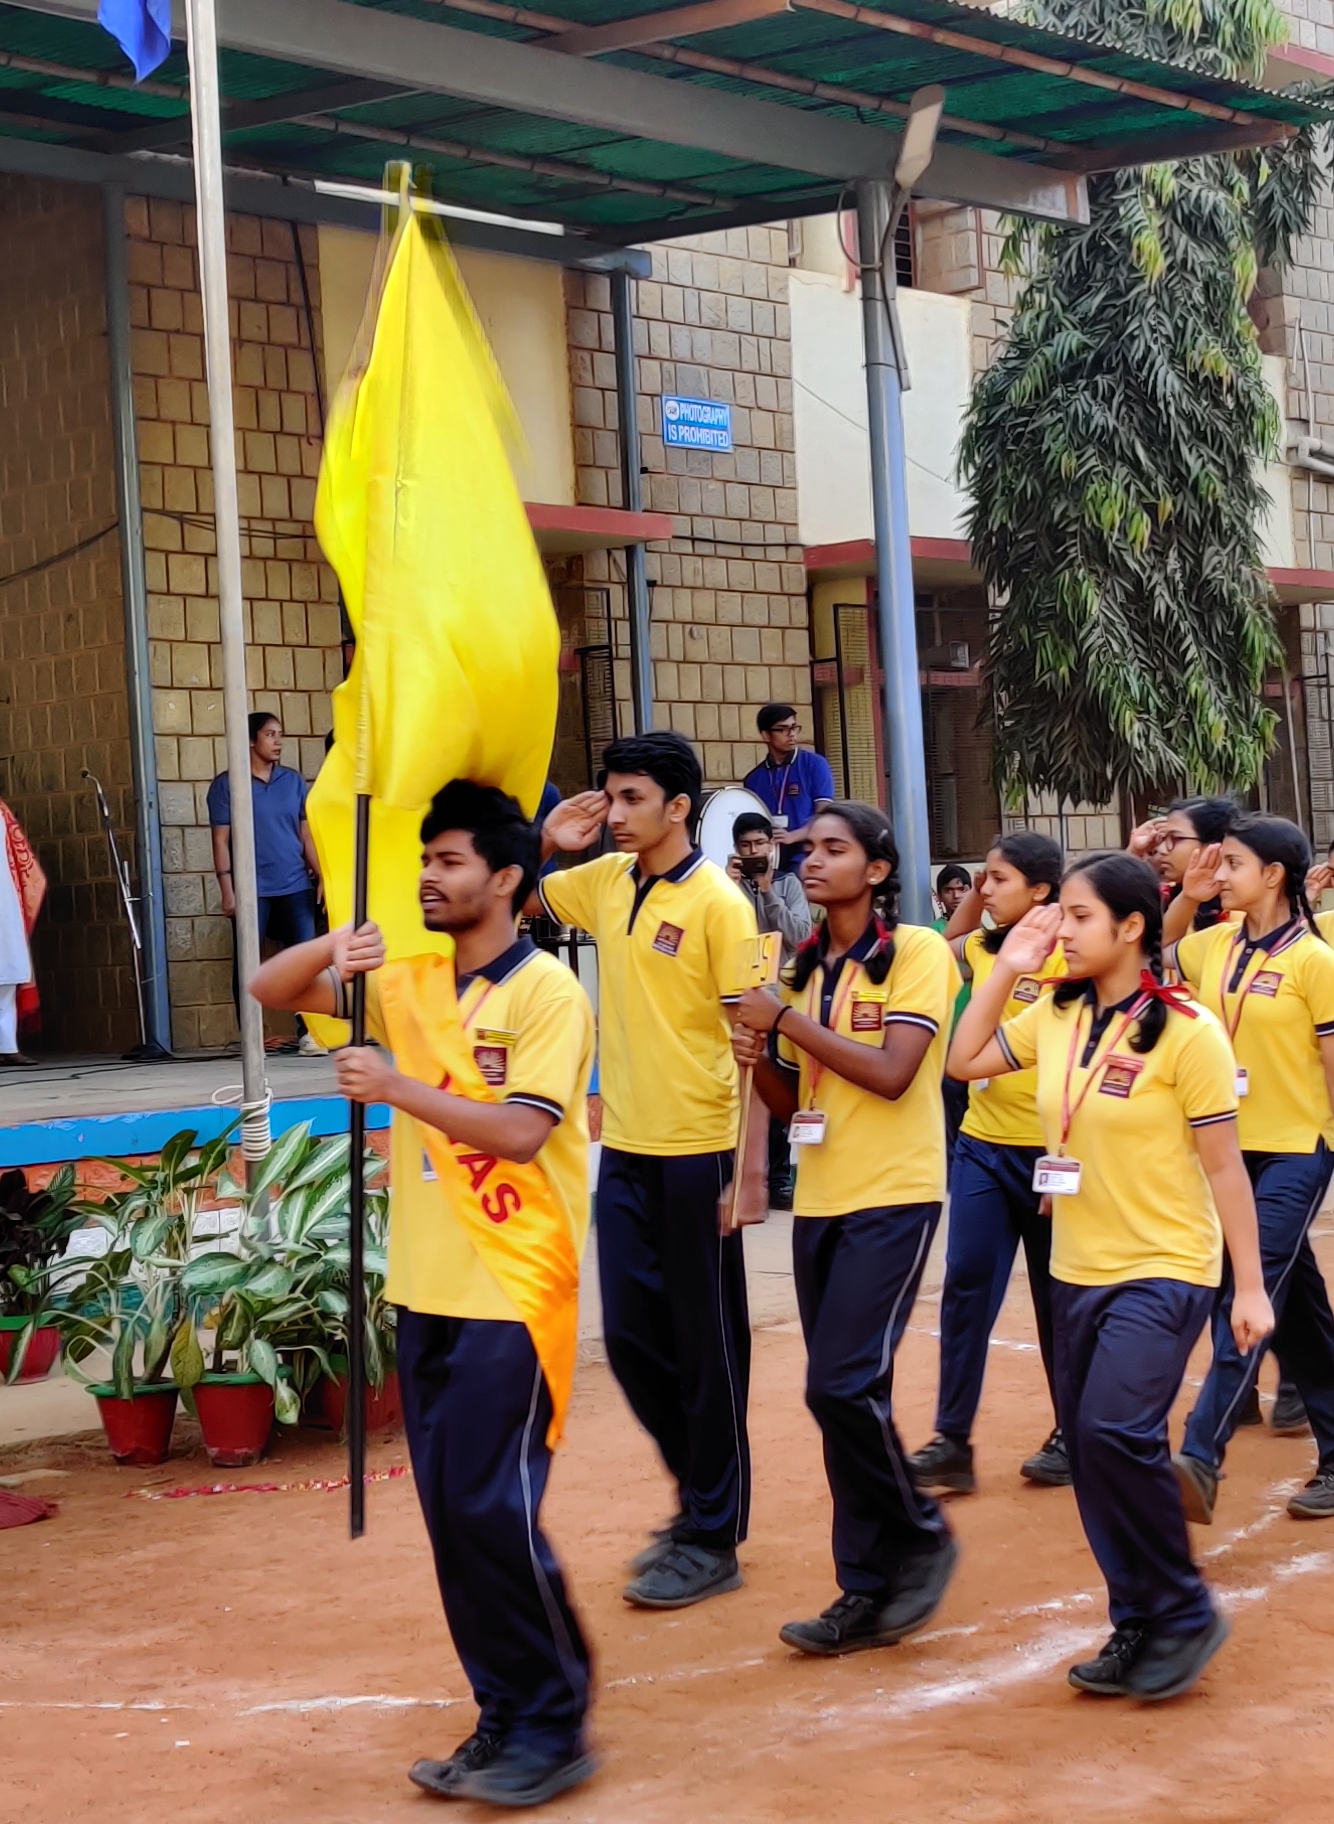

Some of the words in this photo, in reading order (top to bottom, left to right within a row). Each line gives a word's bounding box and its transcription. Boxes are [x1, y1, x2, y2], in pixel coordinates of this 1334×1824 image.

[679, 402, 728, 426] PHOTOGRAPHY
[668, 424, 677, 441] IS
[678, 425, 728, 447] PROHIBITED
